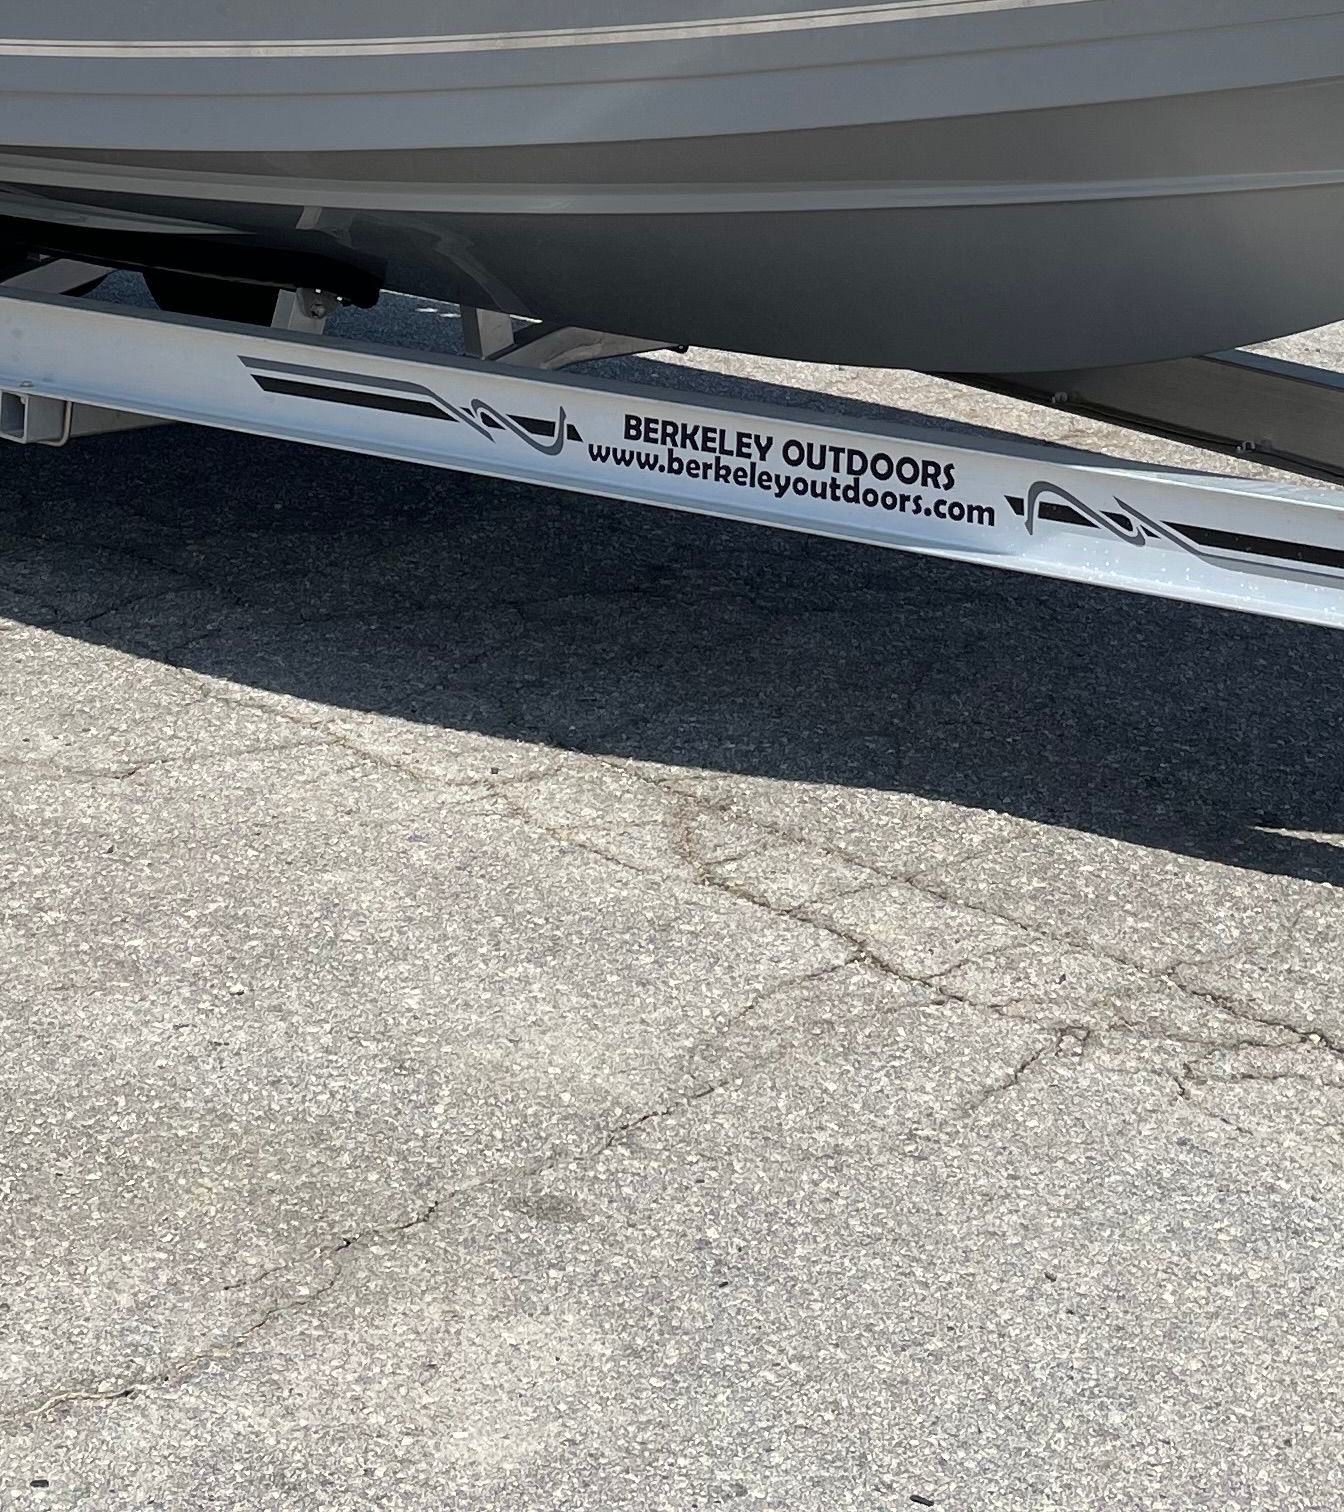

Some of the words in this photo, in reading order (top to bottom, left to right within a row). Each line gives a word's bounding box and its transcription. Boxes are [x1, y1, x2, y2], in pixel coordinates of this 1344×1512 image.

[588, 443, 997, 527] www.berkeleyoutdoors.com
[623, 413, 774, 462] BERKELEY
[781, 438, 956, 492] OUTDOORS
